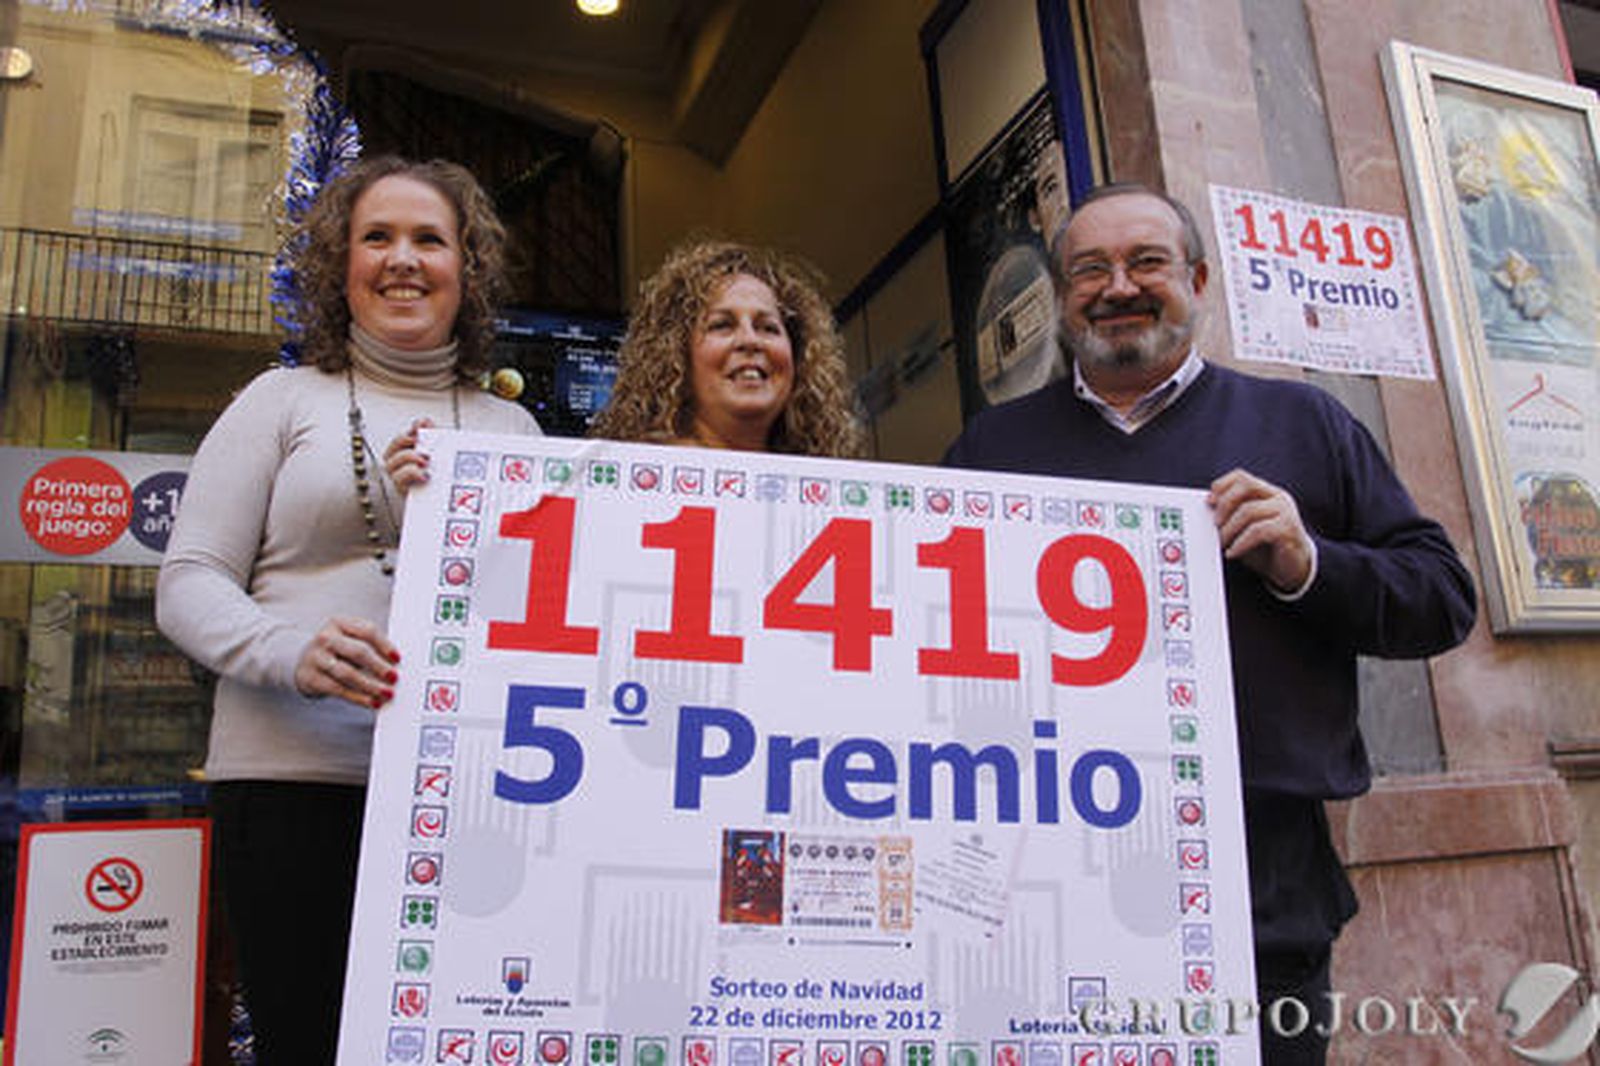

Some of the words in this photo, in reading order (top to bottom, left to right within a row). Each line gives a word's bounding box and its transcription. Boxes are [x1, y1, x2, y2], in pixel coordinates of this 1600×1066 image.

[1234, 203, 1394, 270] 11419
[1287, 267, 1399, 310] Premio
[33, 477, 124, 498] Primera
[26, 499, 86, 518] regla
[91, 500, 130, 517] del
[141, 488, 182, 516] +1
[37, 517, 113, 538] juego:
[143, 514, 172, 533] añ
[486, 494, 1149, 687] 11419
[673, 706, 1142, 830] Premio
[52, 920, 123, 935] PROHIBIDO
[126, 918, 169, 931] FUMAR
[710, 977, 788, 999] Sorteo
[794, 980, 823, 999] de
[830, 980, 924, 1001] Navidad
[689, 1006, 719, 1027] 22
[725, 1007, 755, 1028] de
[762, 1008, 878, 1030] diciembre
[885, 1011, 943, 1031] 2012
